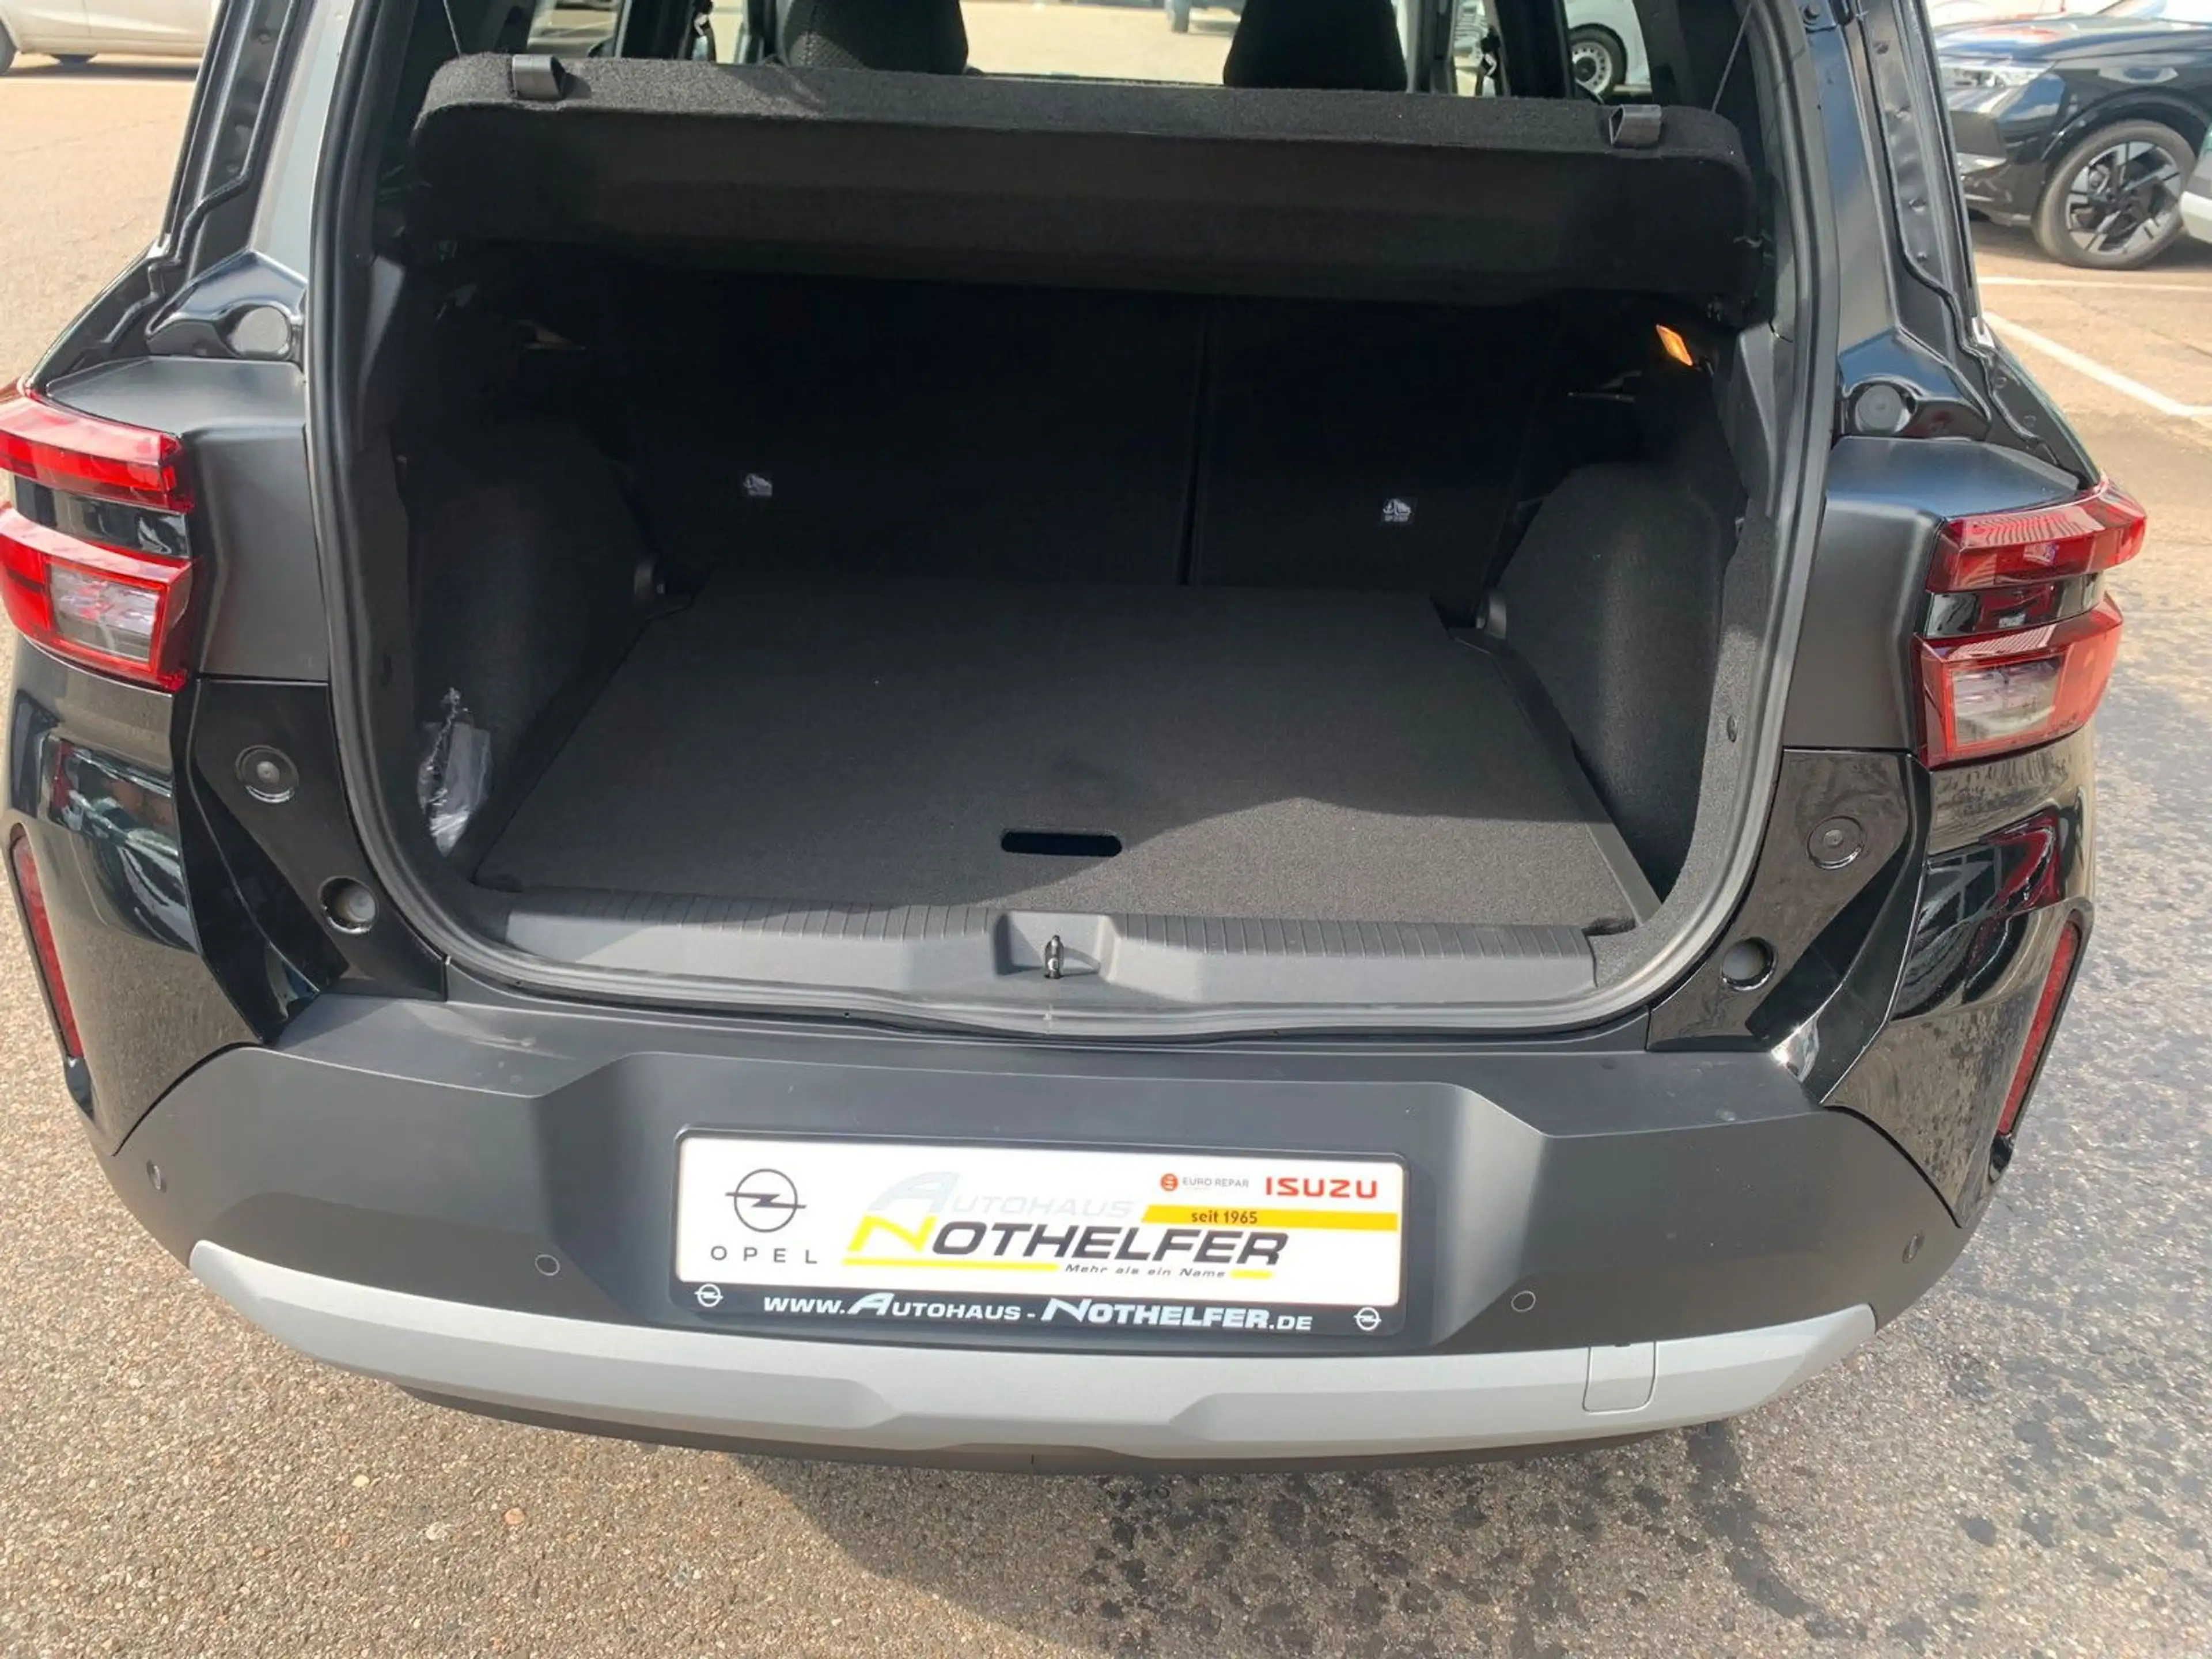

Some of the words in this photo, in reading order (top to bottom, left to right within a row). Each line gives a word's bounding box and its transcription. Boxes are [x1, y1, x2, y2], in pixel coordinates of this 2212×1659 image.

[1182, 1176, 1212, 1187] EURO
[1214, 1177, 1249, 1188] REPAR
[1266, 1177, 1377, 1199] ISUZU
[868, 1171, 1135, 1218] AUTOHAUS
[1191, 1209, 1219, 1224] seit
[1224, 1210, 1257, 1224] 1965
[847, 1215, 1289, 1266] NOTHELFER
[710, 1245, 818, 1264] OPEL
[1065, 1263, 1108, 1274] Mehr
[1115, 1266, 1139, 1275] als
[1147, 1267, 1171, 1277] ein
[1179, 1268, 1226, 1278] Name
